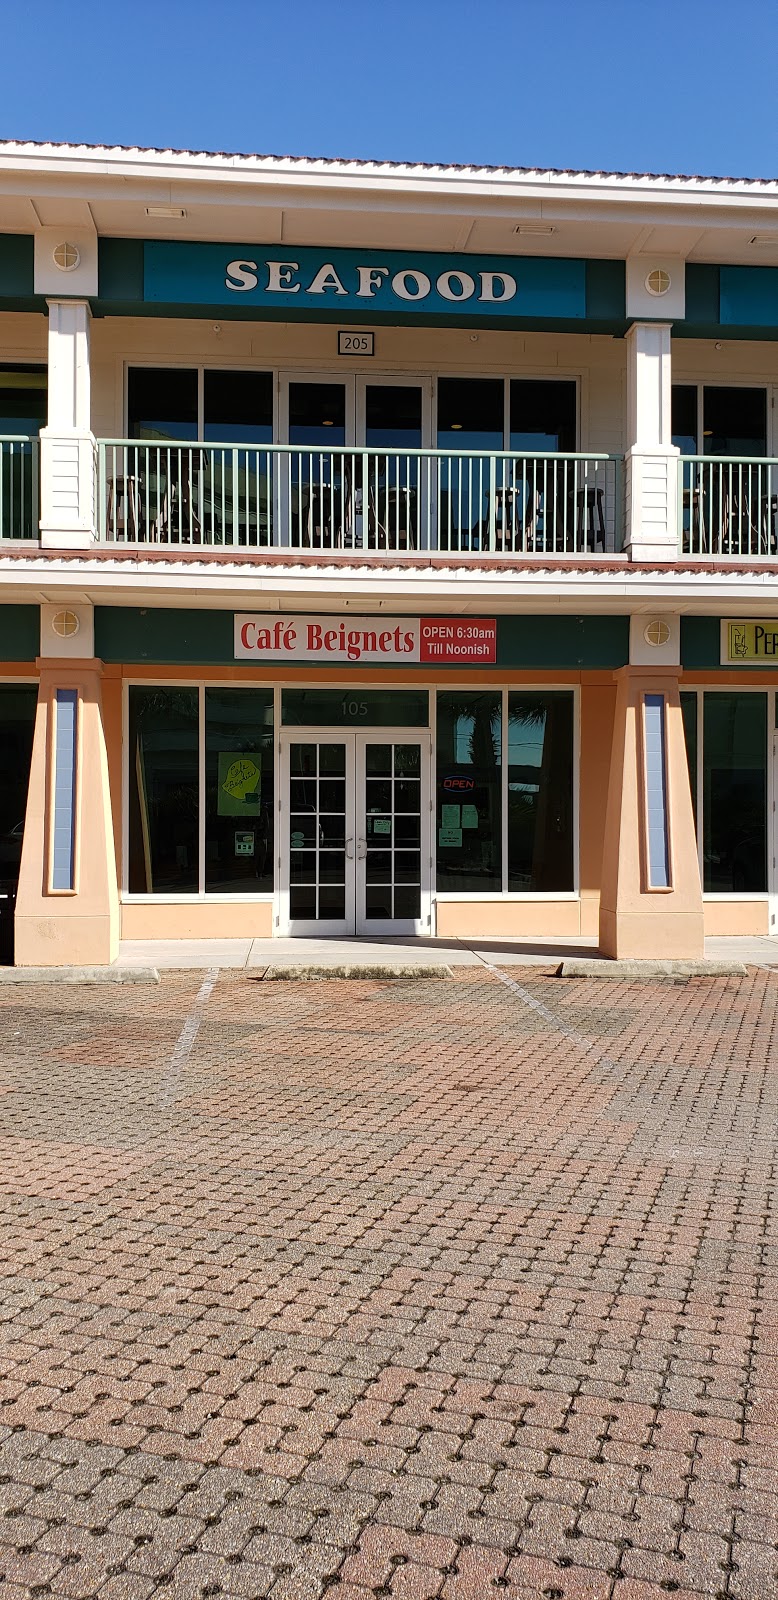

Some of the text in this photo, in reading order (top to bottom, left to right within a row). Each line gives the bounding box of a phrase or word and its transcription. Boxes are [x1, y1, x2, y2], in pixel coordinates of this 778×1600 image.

[224, 260, 518, 303] SEAFOOD
[344, 337, 369, 351] 205
[422, 626, 495, 639] OPEN 6:30am
[240, 621, 415, 660] Café Beignets
[427, 643, 490, 656] Till Noonish
[341, 701, 368, 716] 105
[443, 779, 475, 788] OPEN
